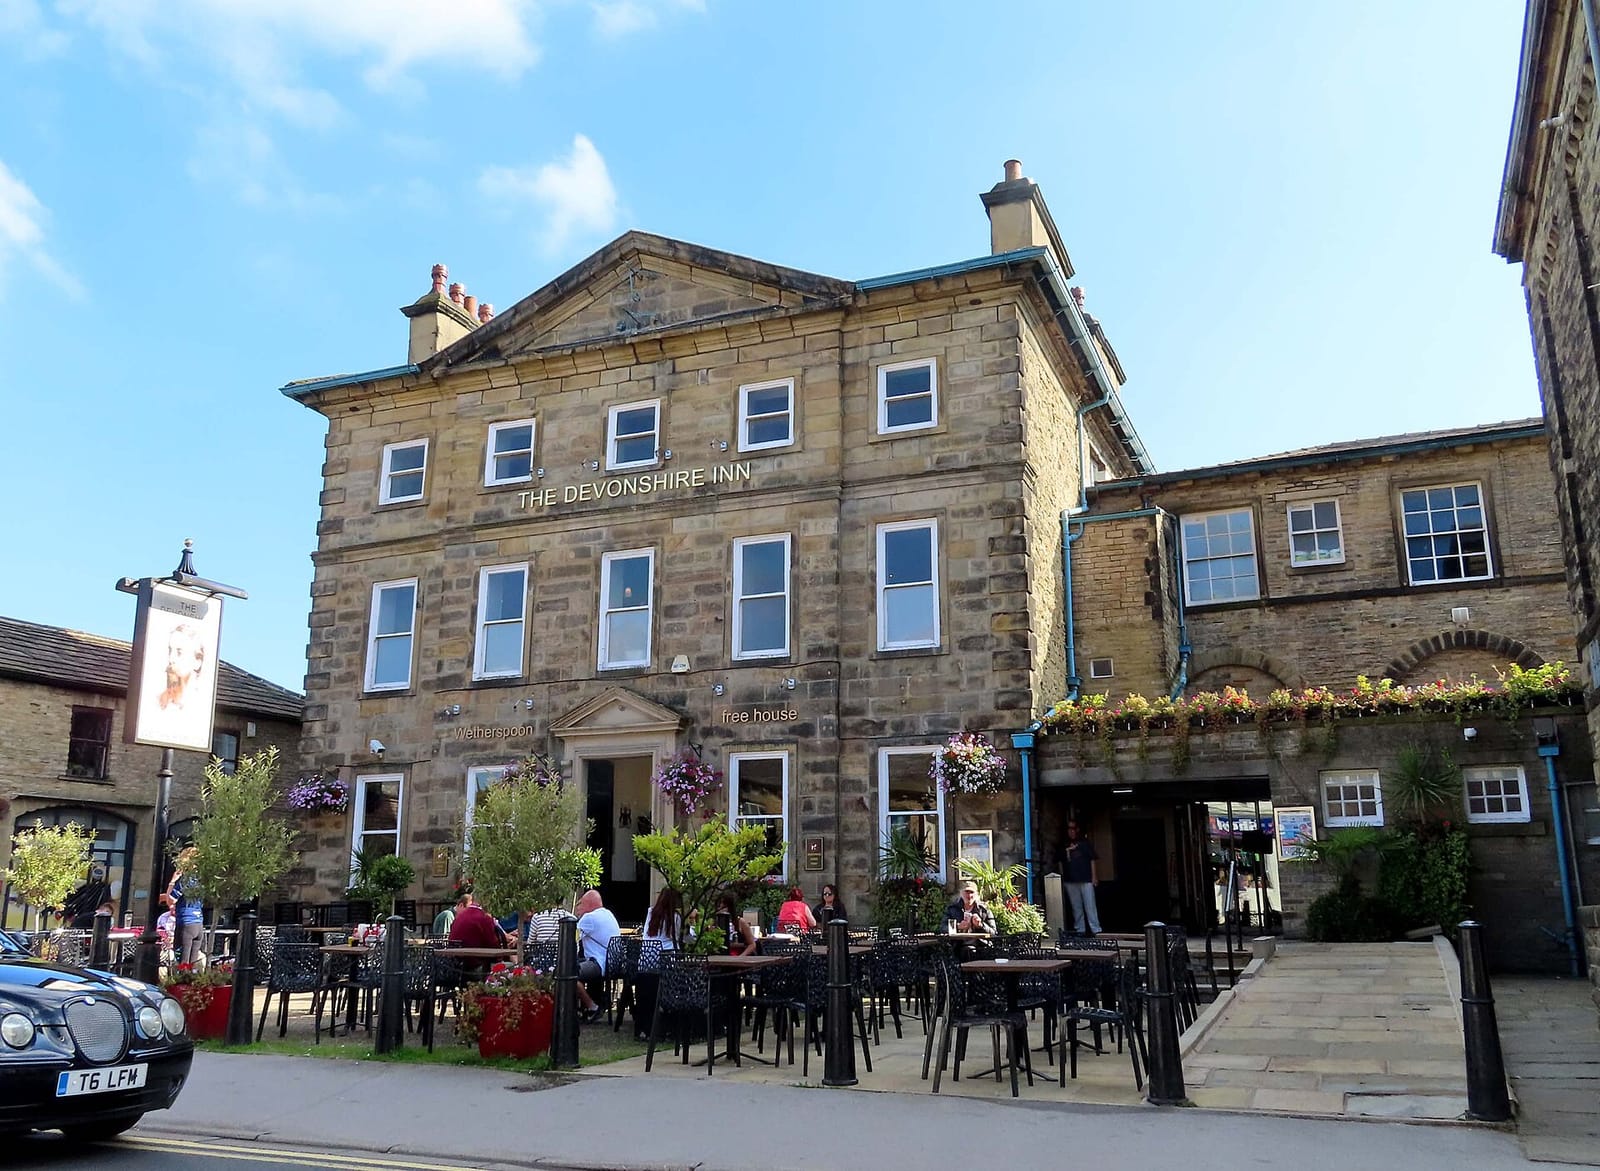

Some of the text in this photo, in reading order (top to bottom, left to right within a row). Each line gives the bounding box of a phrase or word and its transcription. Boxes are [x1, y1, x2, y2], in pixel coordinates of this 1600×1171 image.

[518, 462, 751, 509] THE DEVONSHIRE INN
[180, 602, 197, 613] THE
[722, 708, 798, 723] free house
[454, 725, 534, 740] Wetherspoon
[80, 1068, 138, 1091] T6 LFM
